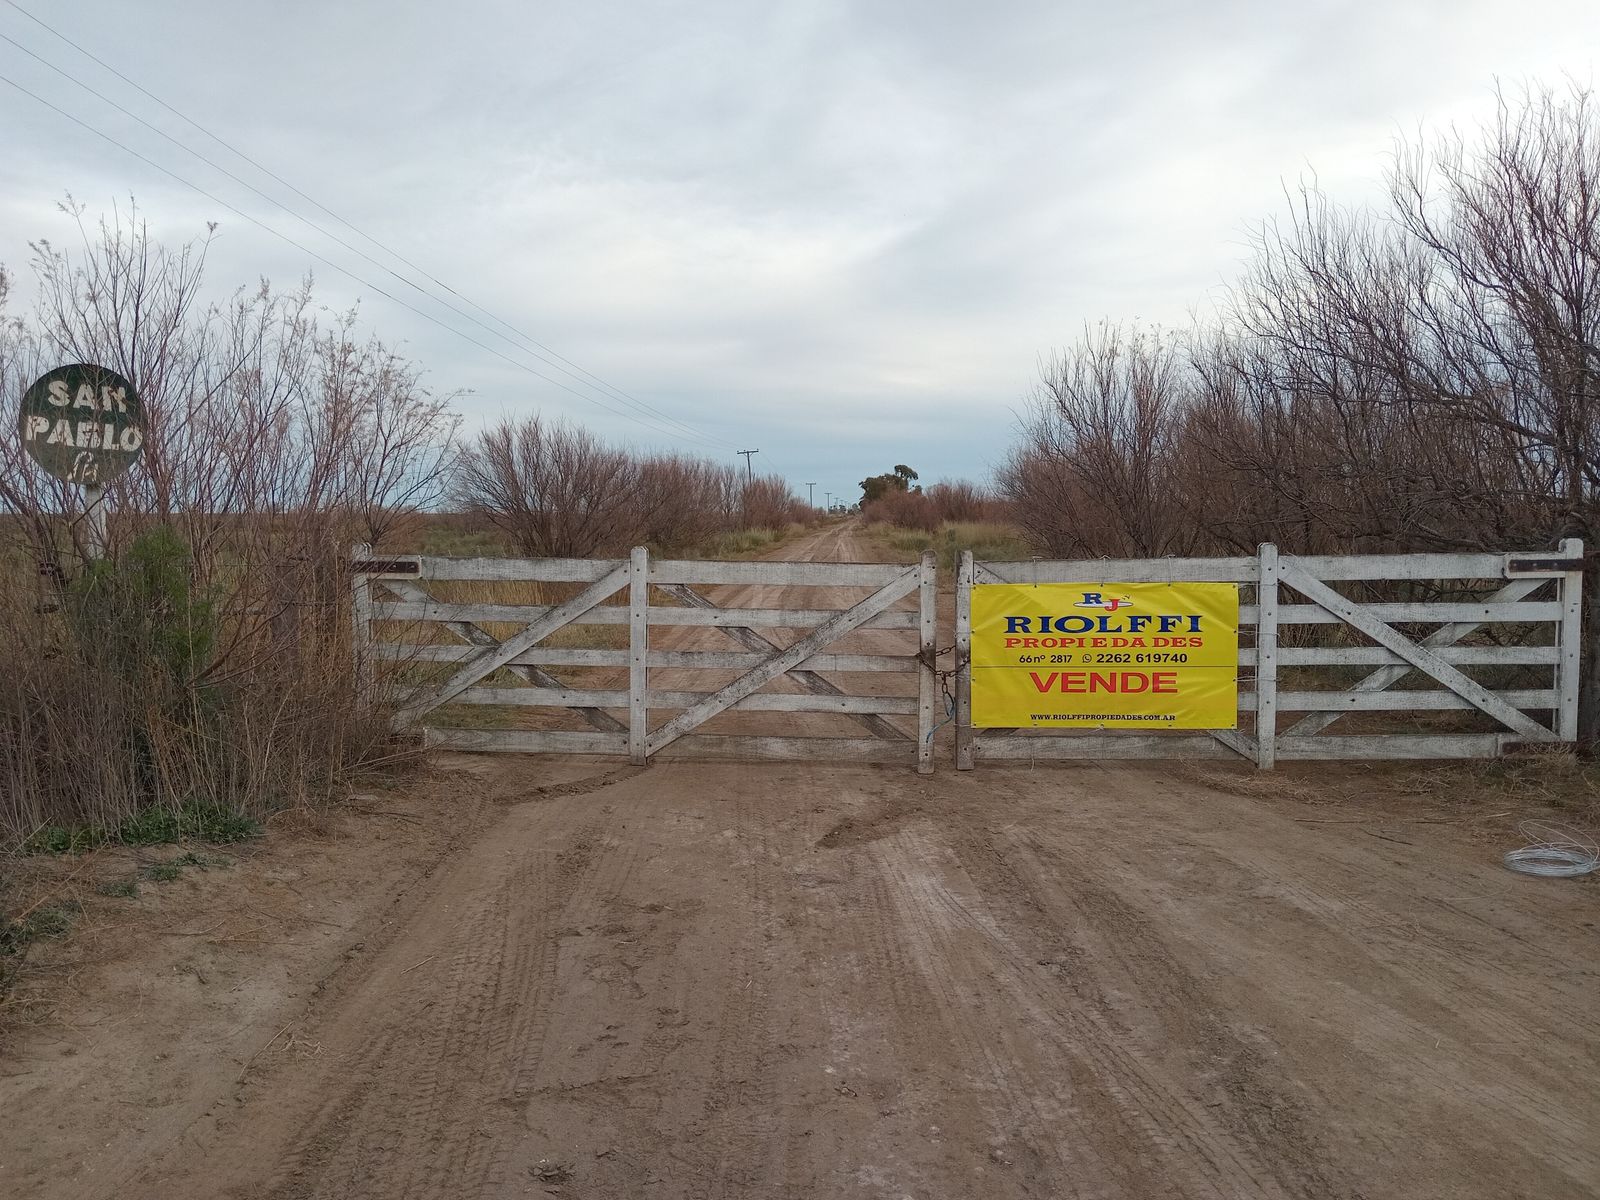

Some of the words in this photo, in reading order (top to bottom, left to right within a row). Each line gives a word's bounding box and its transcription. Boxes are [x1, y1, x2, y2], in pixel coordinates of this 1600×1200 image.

[47, 380, 127, 413] SAN
[26, 415, 143, 452] PABLO
[1003, 615, 1204, 634] RIOLFFI
[1003, 637, 1204, 649] PROPIEDADES
[1049, 654, 1073, 664] 2817
[1096, 653, 1131, 663] 2262
[1135, 653, 1188, 664] 619740
[1029, 671, 1178, 694] VENDE
[1030, 713, 1176, 722] WWW.RIOLFFIPROPIEDADES.COM.AR
